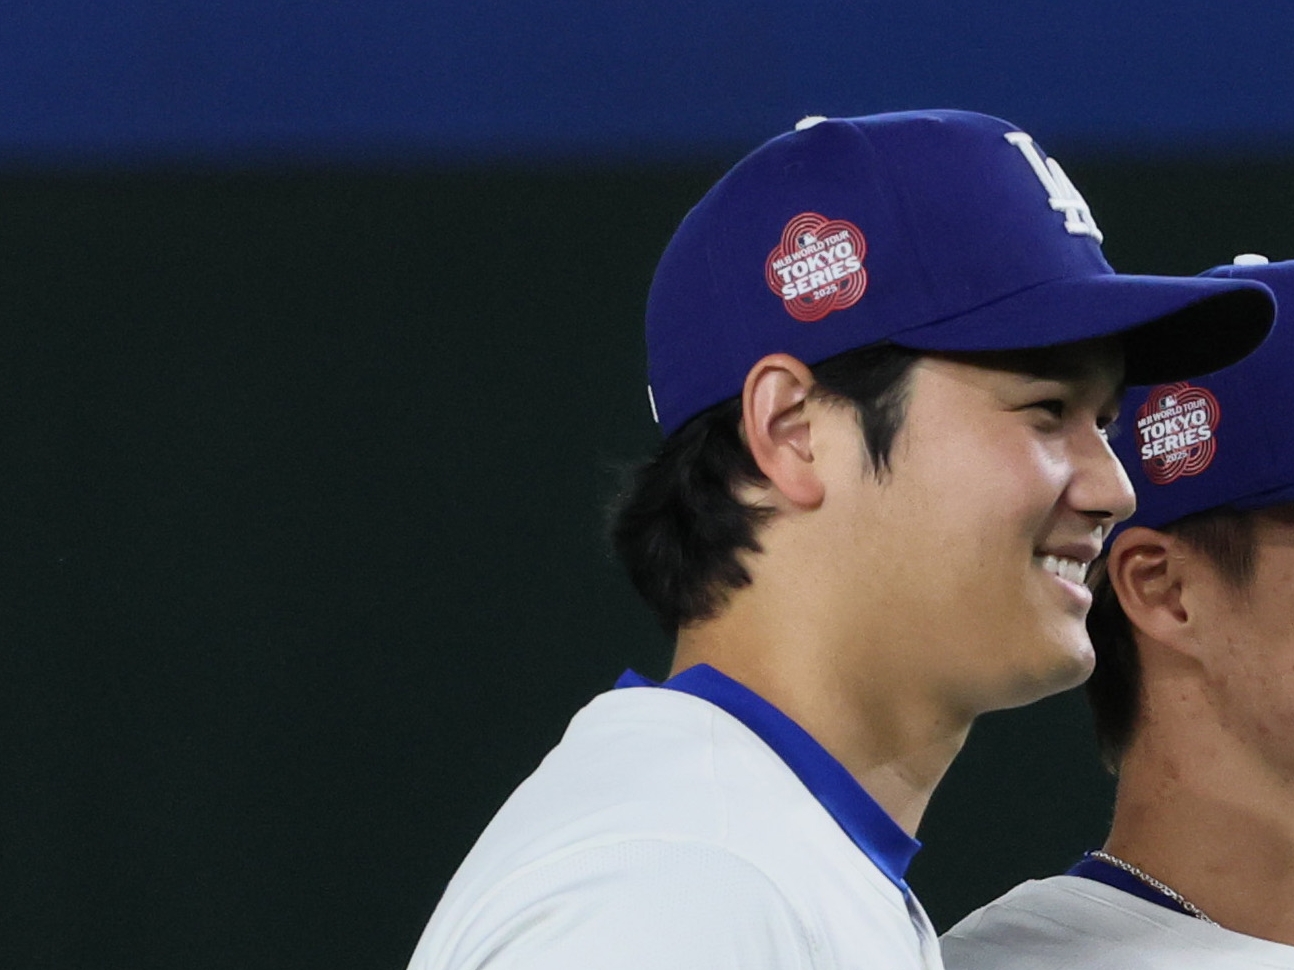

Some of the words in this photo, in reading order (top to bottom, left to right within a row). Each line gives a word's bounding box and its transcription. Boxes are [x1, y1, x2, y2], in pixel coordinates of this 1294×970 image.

[1003, 131, 1103, 244] LA
[772, 254, 793, 270] MLB
[792, 241, 824, 261] WORLD
[825, 230, 851, 246] TOUR
[777, 242, 852, 283] TOKYO
[781, 256, 861, 300] SERIES
[813, 284, 838, 300] 2025
[1140, 410, 1207, 442] TOKYO
[1152, 405, 1182, 421] WORLD
[1183, 398, 1206, 412] TOUR
[1141, 425, 1212, 460] SERIES
